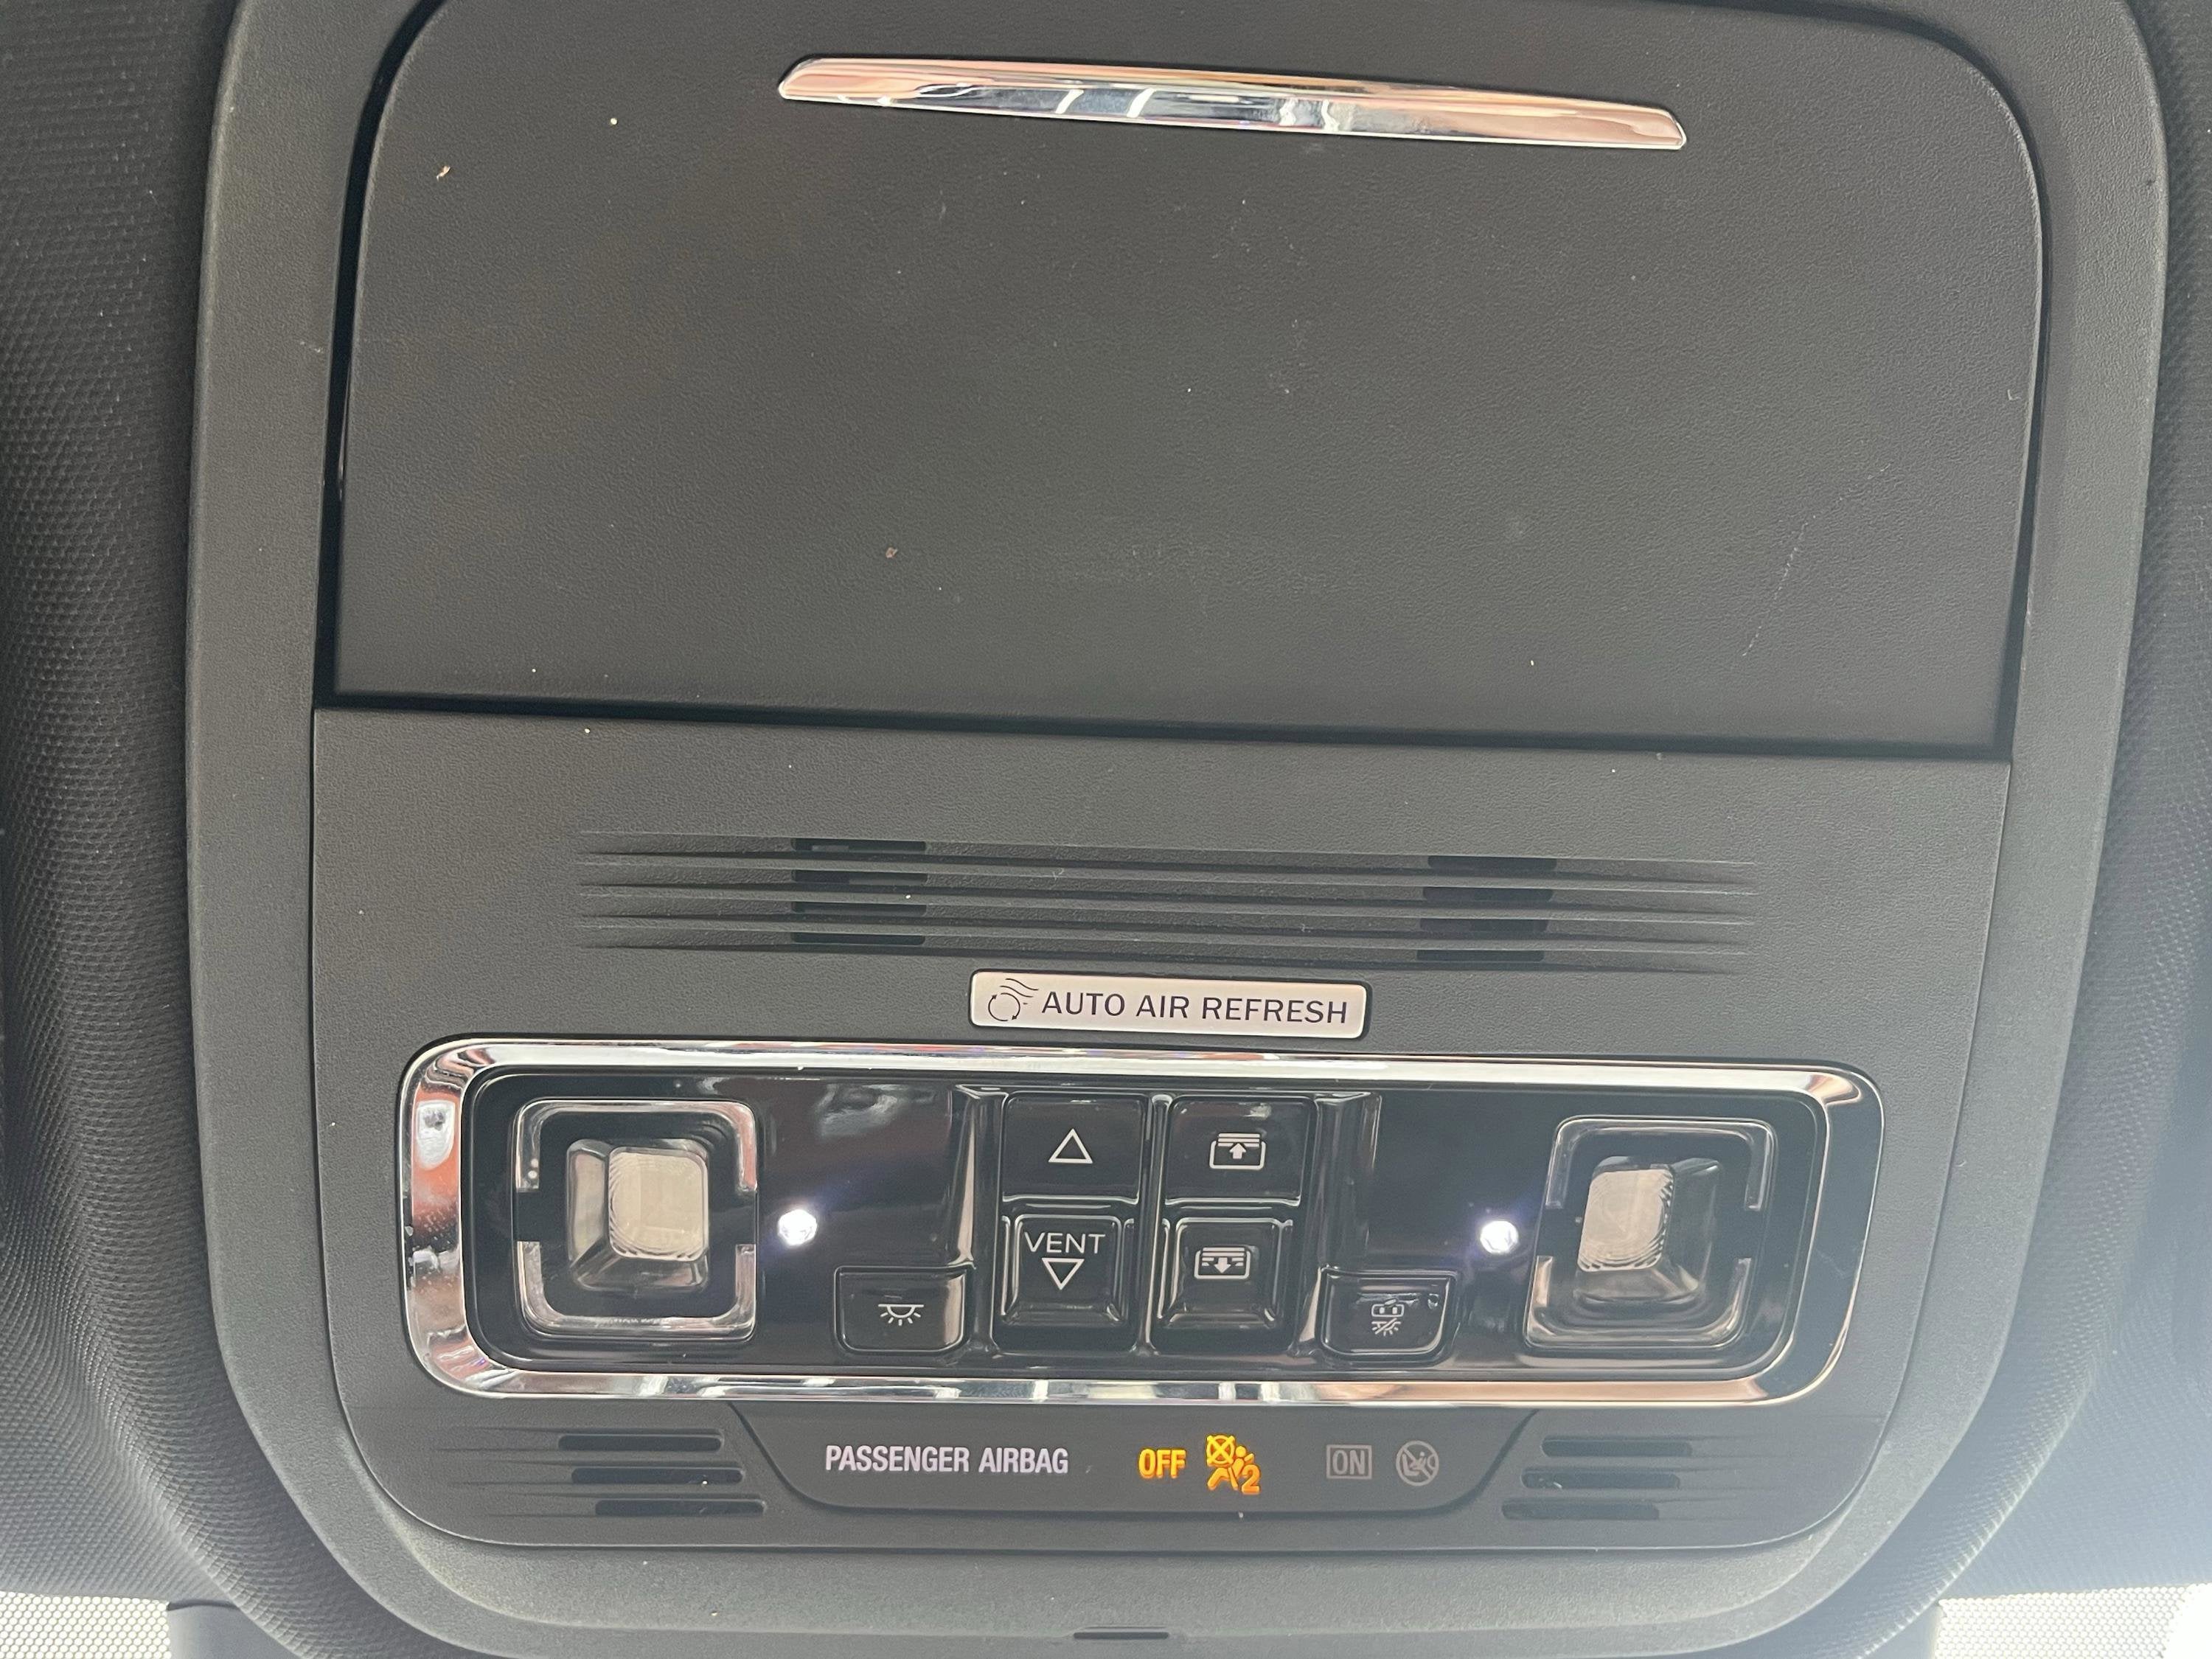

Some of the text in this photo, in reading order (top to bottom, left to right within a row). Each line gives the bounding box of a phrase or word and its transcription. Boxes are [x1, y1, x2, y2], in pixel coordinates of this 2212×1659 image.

[1042, 992, 1347, 1023] AUTO AIR REFRESH
[1024, 1233, 1105, 1253] VENT
[826, 1445, 1186, 1479] PASSENGER AIRBAG OFF
[1332, 1450, 1366, 1475] ON
